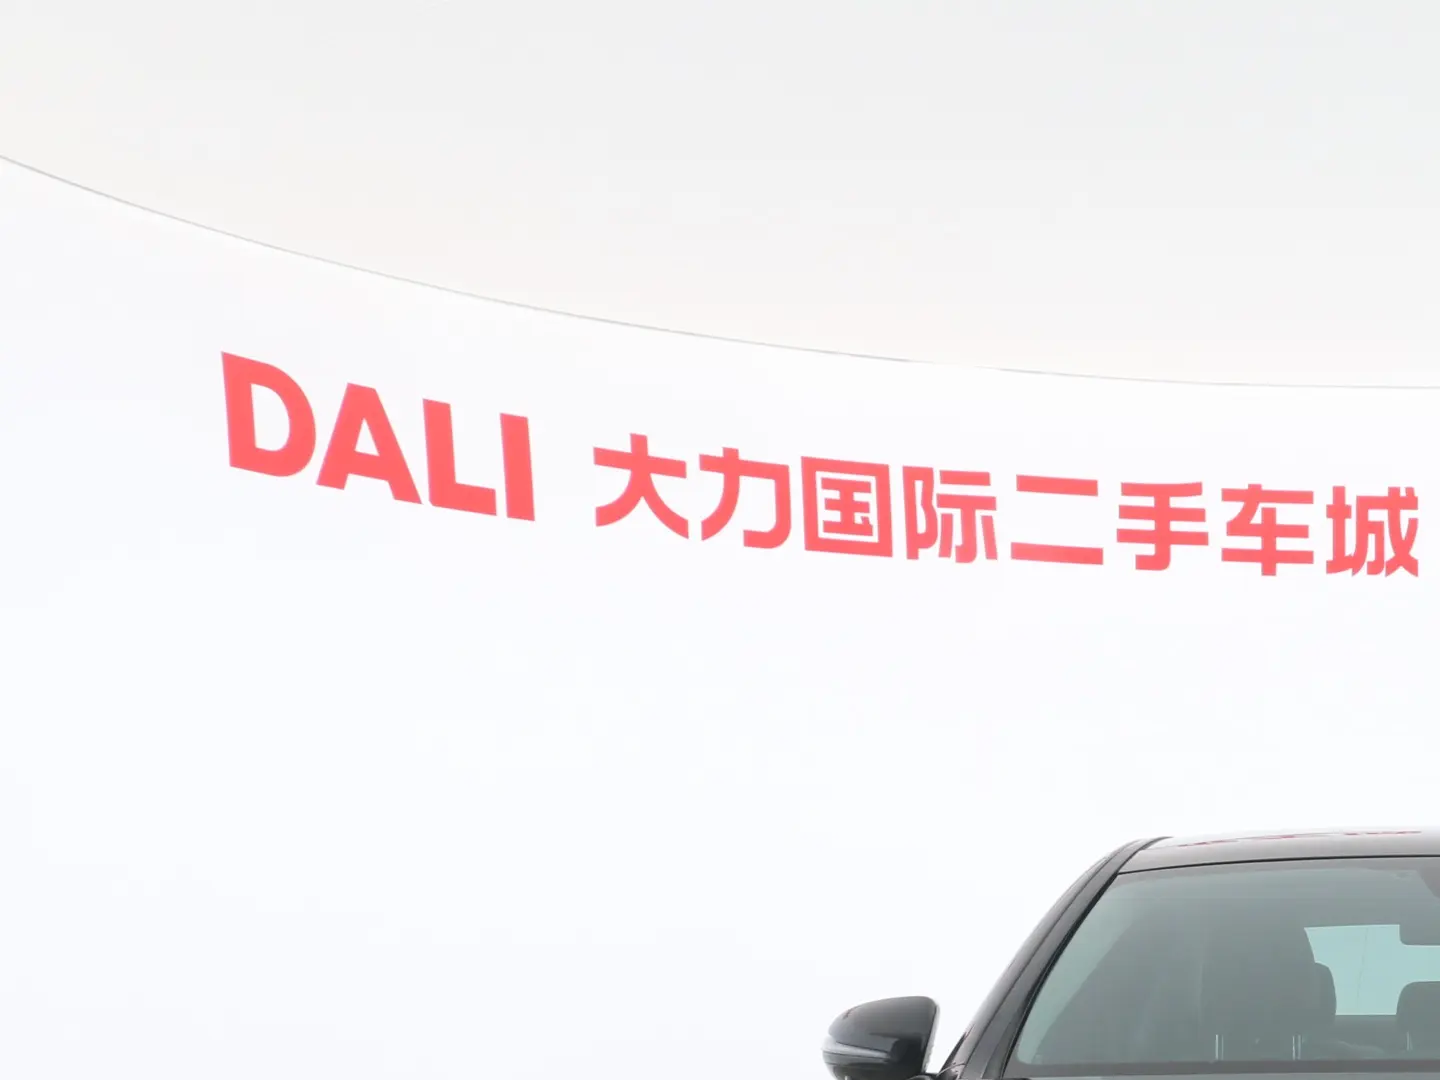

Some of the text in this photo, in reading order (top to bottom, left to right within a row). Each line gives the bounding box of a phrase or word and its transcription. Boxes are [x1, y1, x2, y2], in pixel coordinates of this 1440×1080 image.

[222, 352, 1419, 576] DALI 大力国际二手车城
